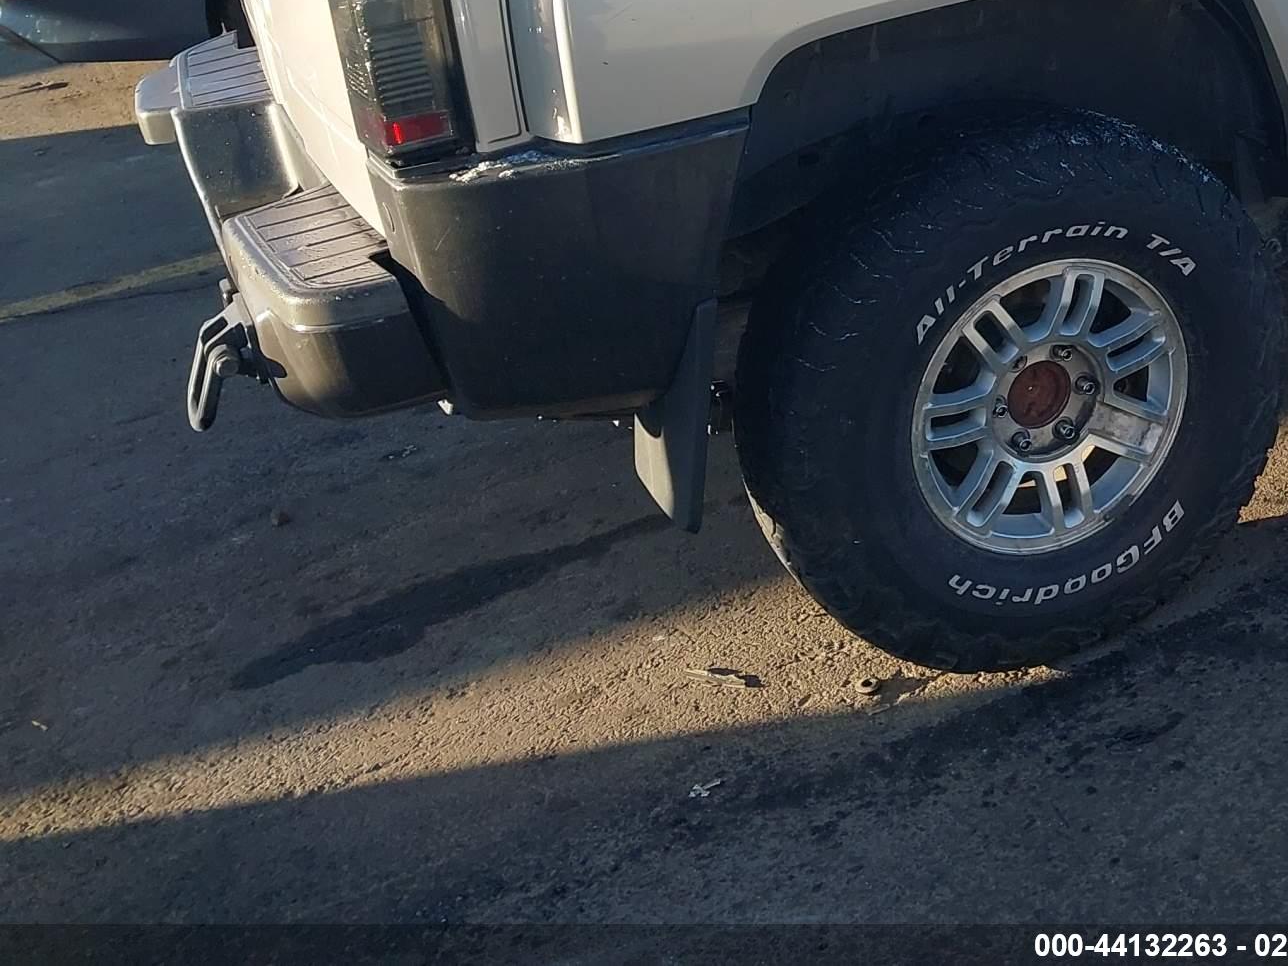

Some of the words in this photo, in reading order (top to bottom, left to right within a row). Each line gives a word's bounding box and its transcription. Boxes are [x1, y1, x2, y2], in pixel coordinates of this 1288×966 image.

[914, 221, 1129, 345] All-Terrain
[1146, 233, 1200, 277] T/A
[948, 499, 1185, 606] BFGoodrich
